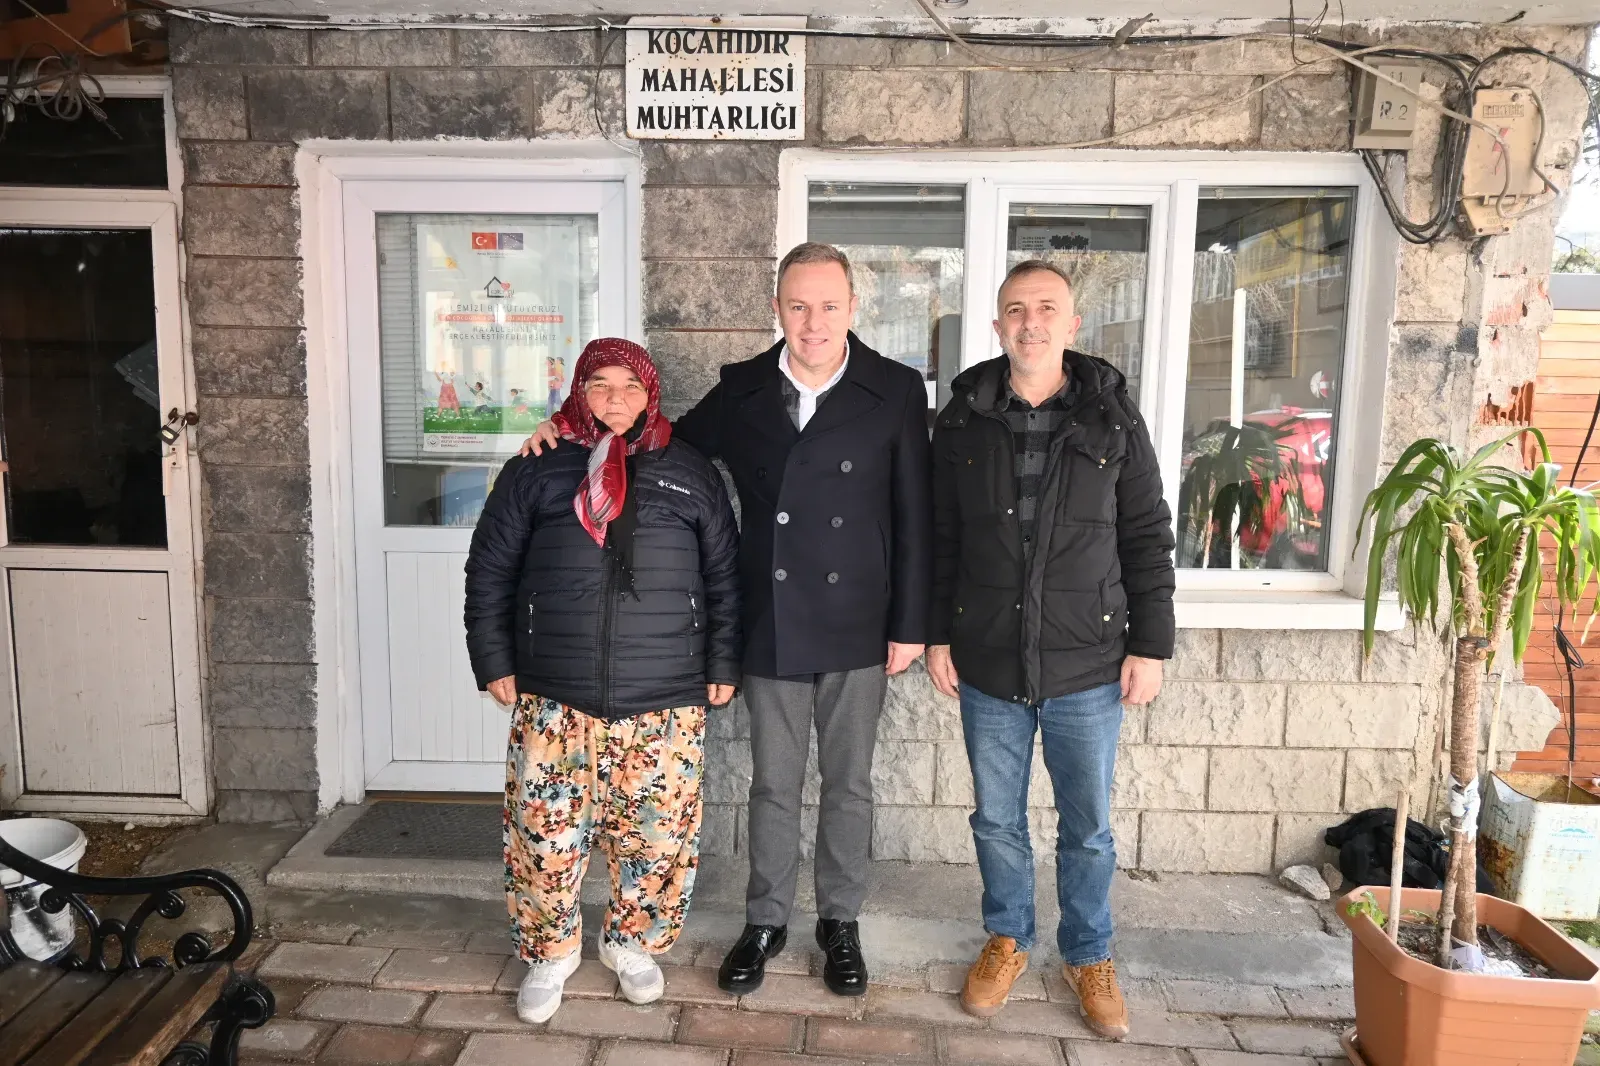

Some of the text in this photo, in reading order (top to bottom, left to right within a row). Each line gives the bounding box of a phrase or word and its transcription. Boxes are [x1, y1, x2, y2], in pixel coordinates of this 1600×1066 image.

[647, 30, 790, 56] KOCAHIDIR
[640, 63, 794, 93] MAHALLESİ
[637, 102, 796, 130] MUHTARLIĞI
